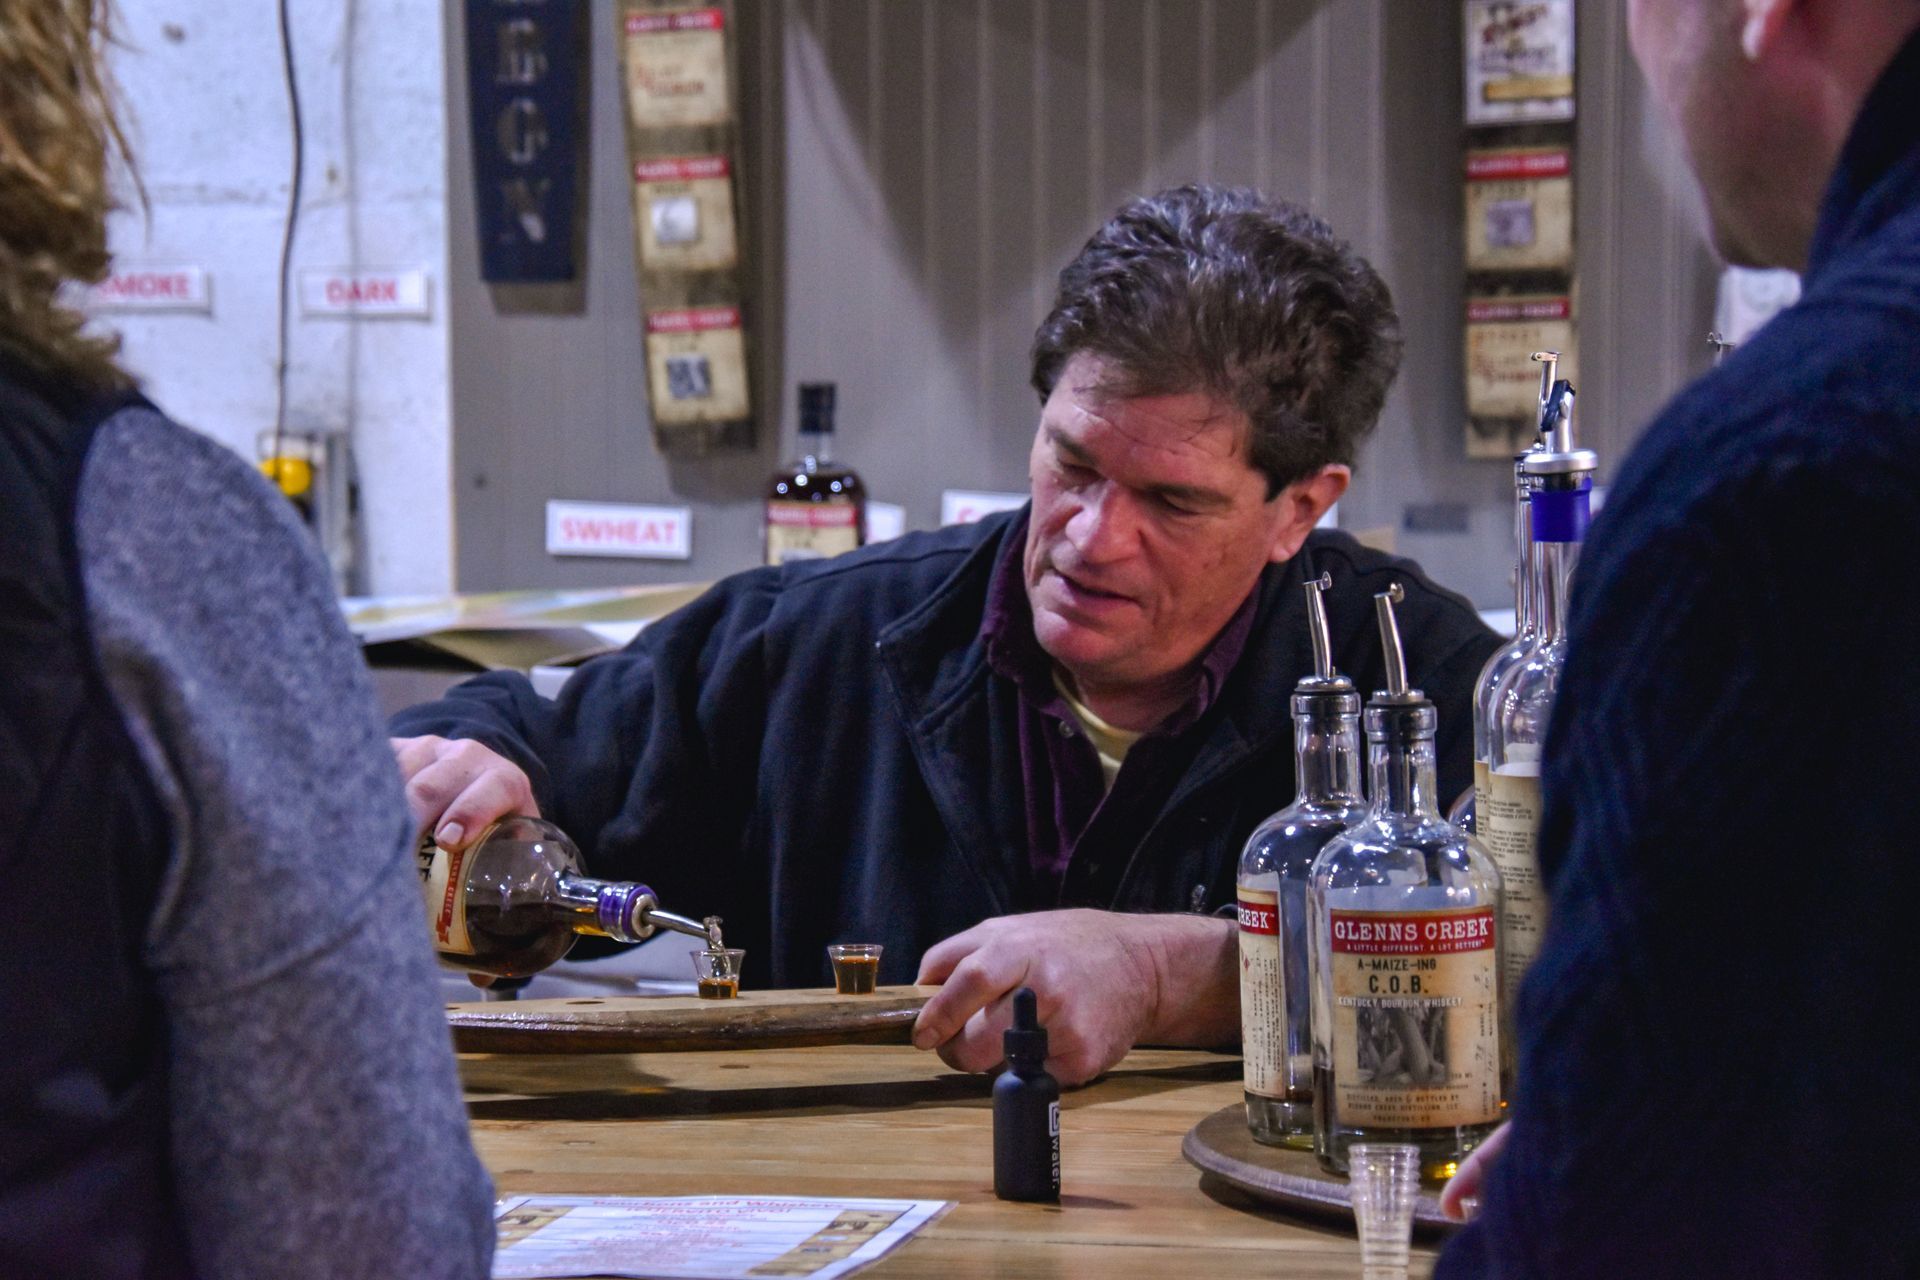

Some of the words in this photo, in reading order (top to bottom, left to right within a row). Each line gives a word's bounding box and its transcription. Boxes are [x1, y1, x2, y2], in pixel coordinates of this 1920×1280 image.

[325, 278, 397, 305] DARK
[560, 516, 676, 545] SWHEAT
[1237, 906, 1269, 929] REEK
[1334, 921, 1418, 942] GLENNS
[1425, 917, 1489, 940] CREEK
[1357, 958, 1437, 972] A-MAIZE-ING
[1368, 974, 1430, 995] C.O.B.
[1338, 997, 1378, 1008] KENTUCKY
[1381, 998, 1420, 1009] BOURBON
[1424, 996, 1463, 1008] WHISKEY
